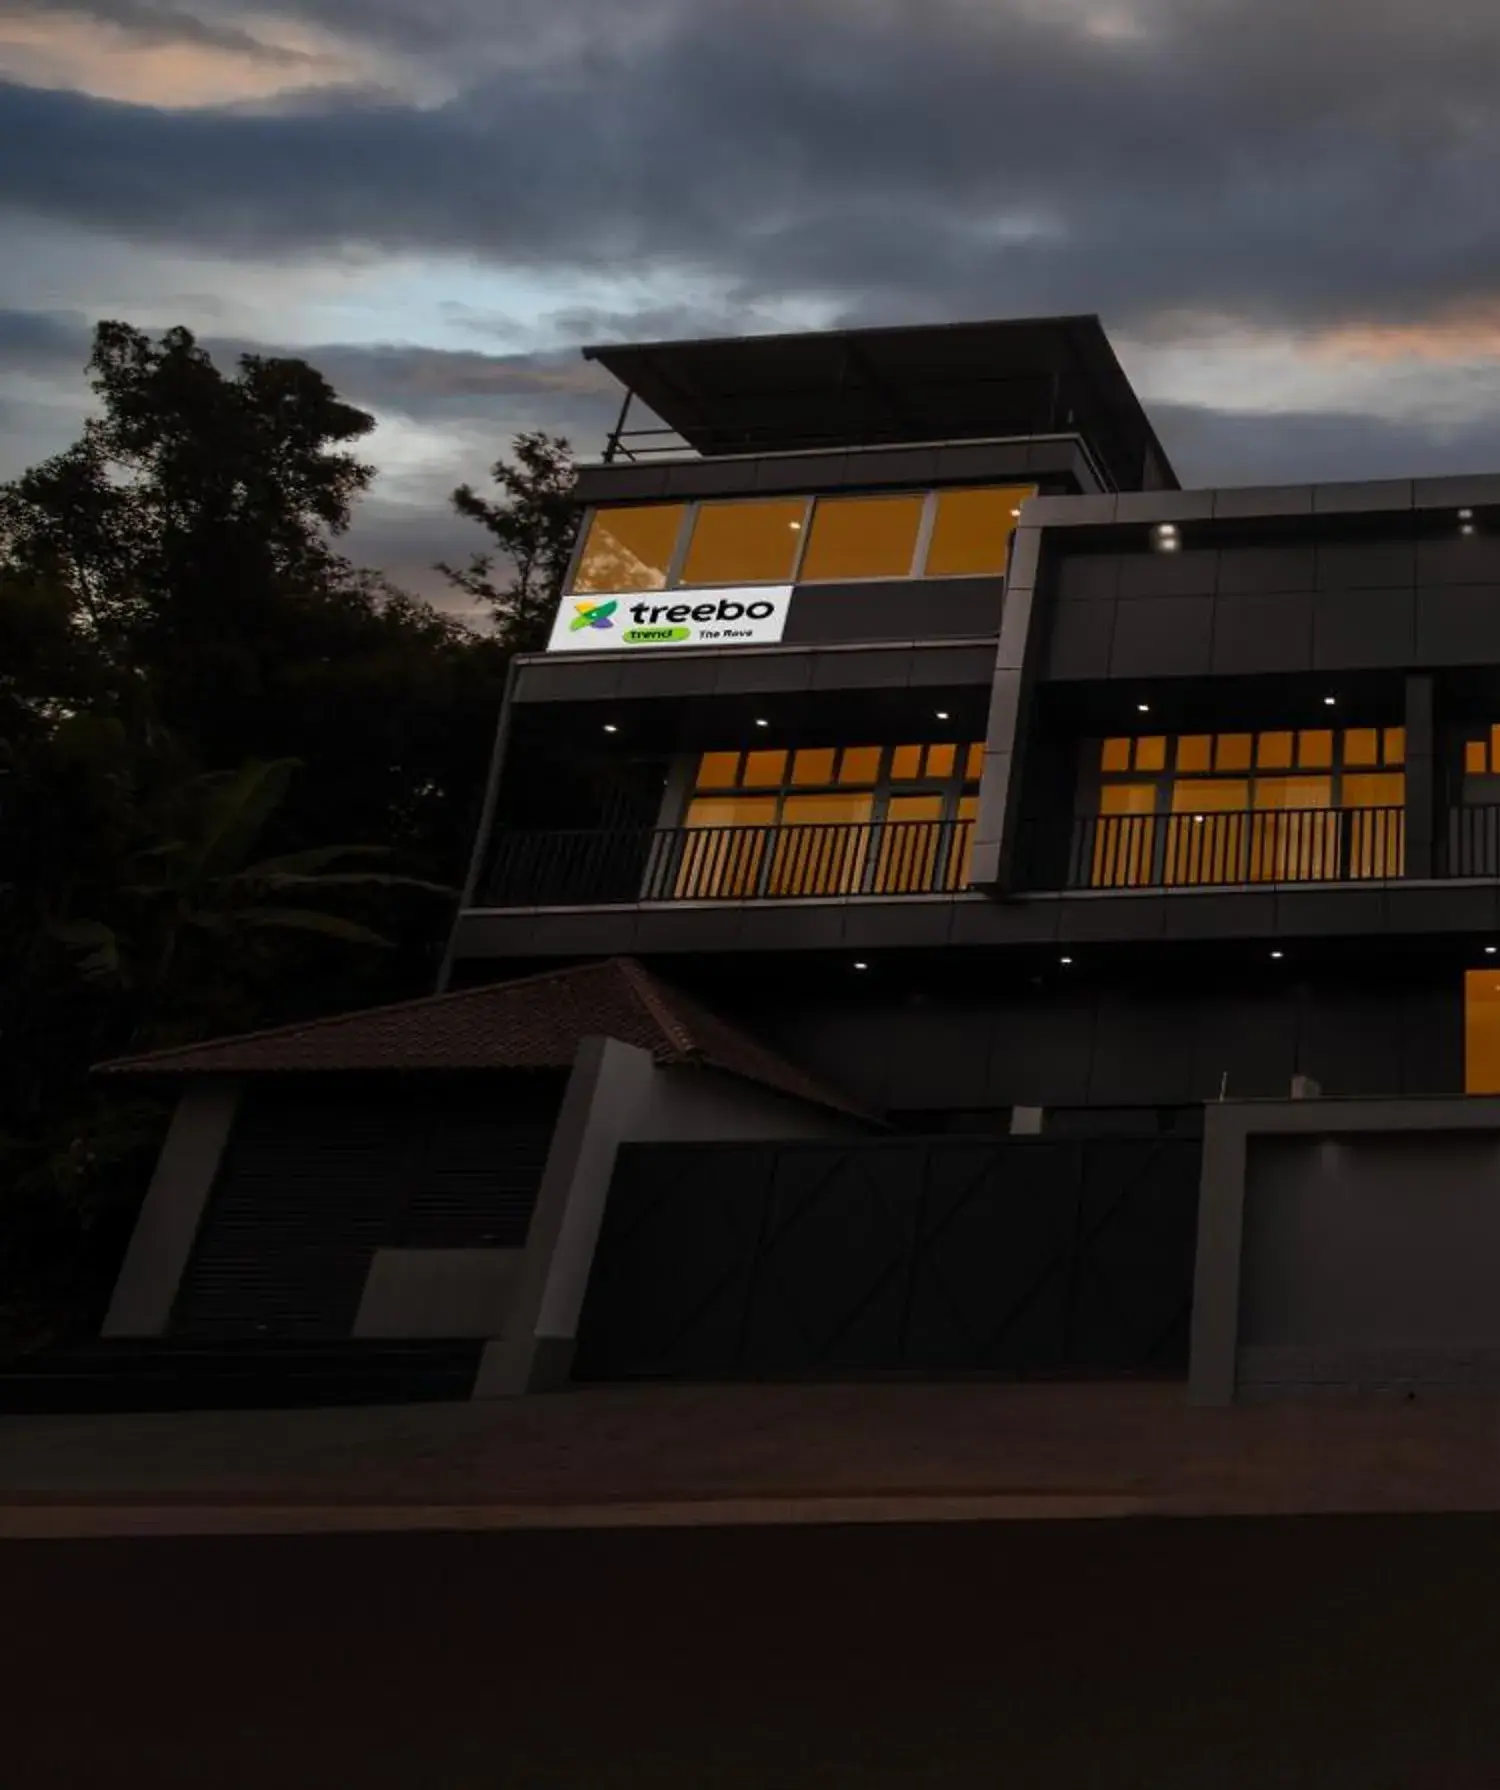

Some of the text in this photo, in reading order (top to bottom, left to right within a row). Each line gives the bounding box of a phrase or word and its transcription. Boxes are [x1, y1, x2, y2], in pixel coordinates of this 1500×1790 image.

[629, 599, 774, 624] treebo
[630, 629, 673, 639] trend
[699, 629, 721, 640] The
